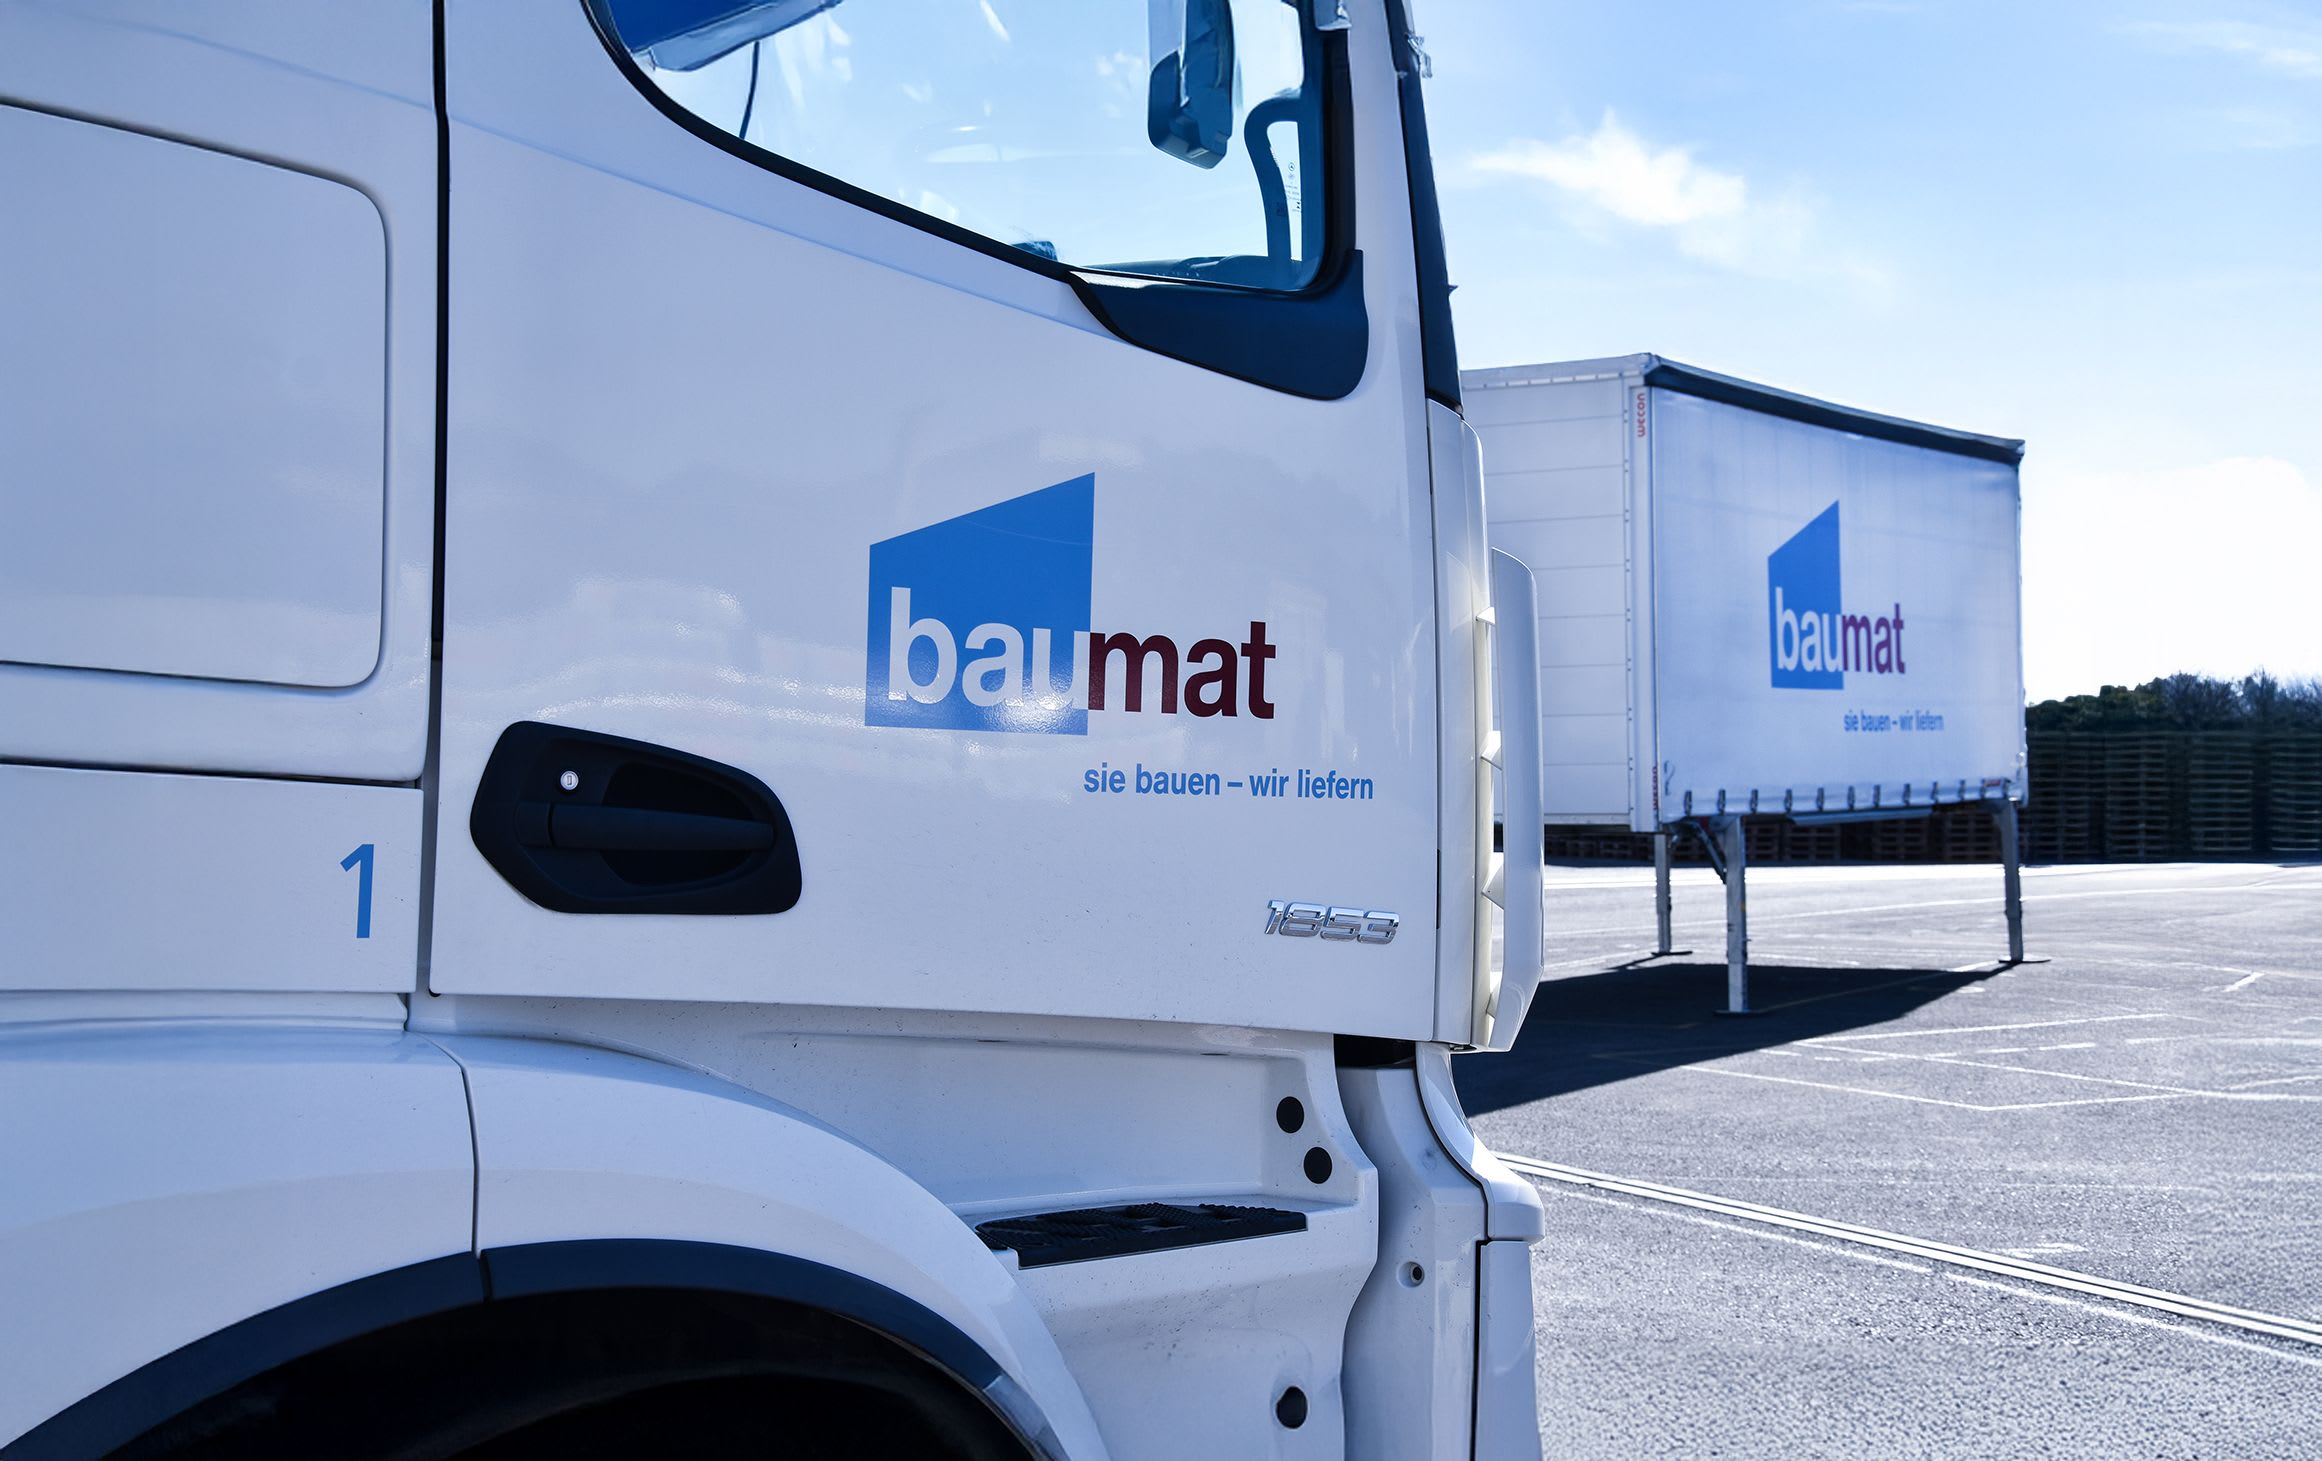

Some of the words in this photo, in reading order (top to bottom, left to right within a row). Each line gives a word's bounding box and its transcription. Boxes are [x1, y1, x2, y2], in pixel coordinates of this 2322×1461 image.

[888, 586, 1276, 720] baumat
[1775, 586, 1906, 675] baumat
[1843, 709, 1859, 732] sie
[1861, 709, 1891, 732] bauen
[1899, 709, 1914, 732] wir
[1915, 709, 1945, 732] liefern
[1083, 762, 1126, 794] sie
[1135, 763, 1220, 796] bauen
[1249, 767, 1290, 798] wir
[1297, 769, 1374, 800] liefern
[340, 843, 375, 939] 1
[1264, 899, 1400, 945] 1853
